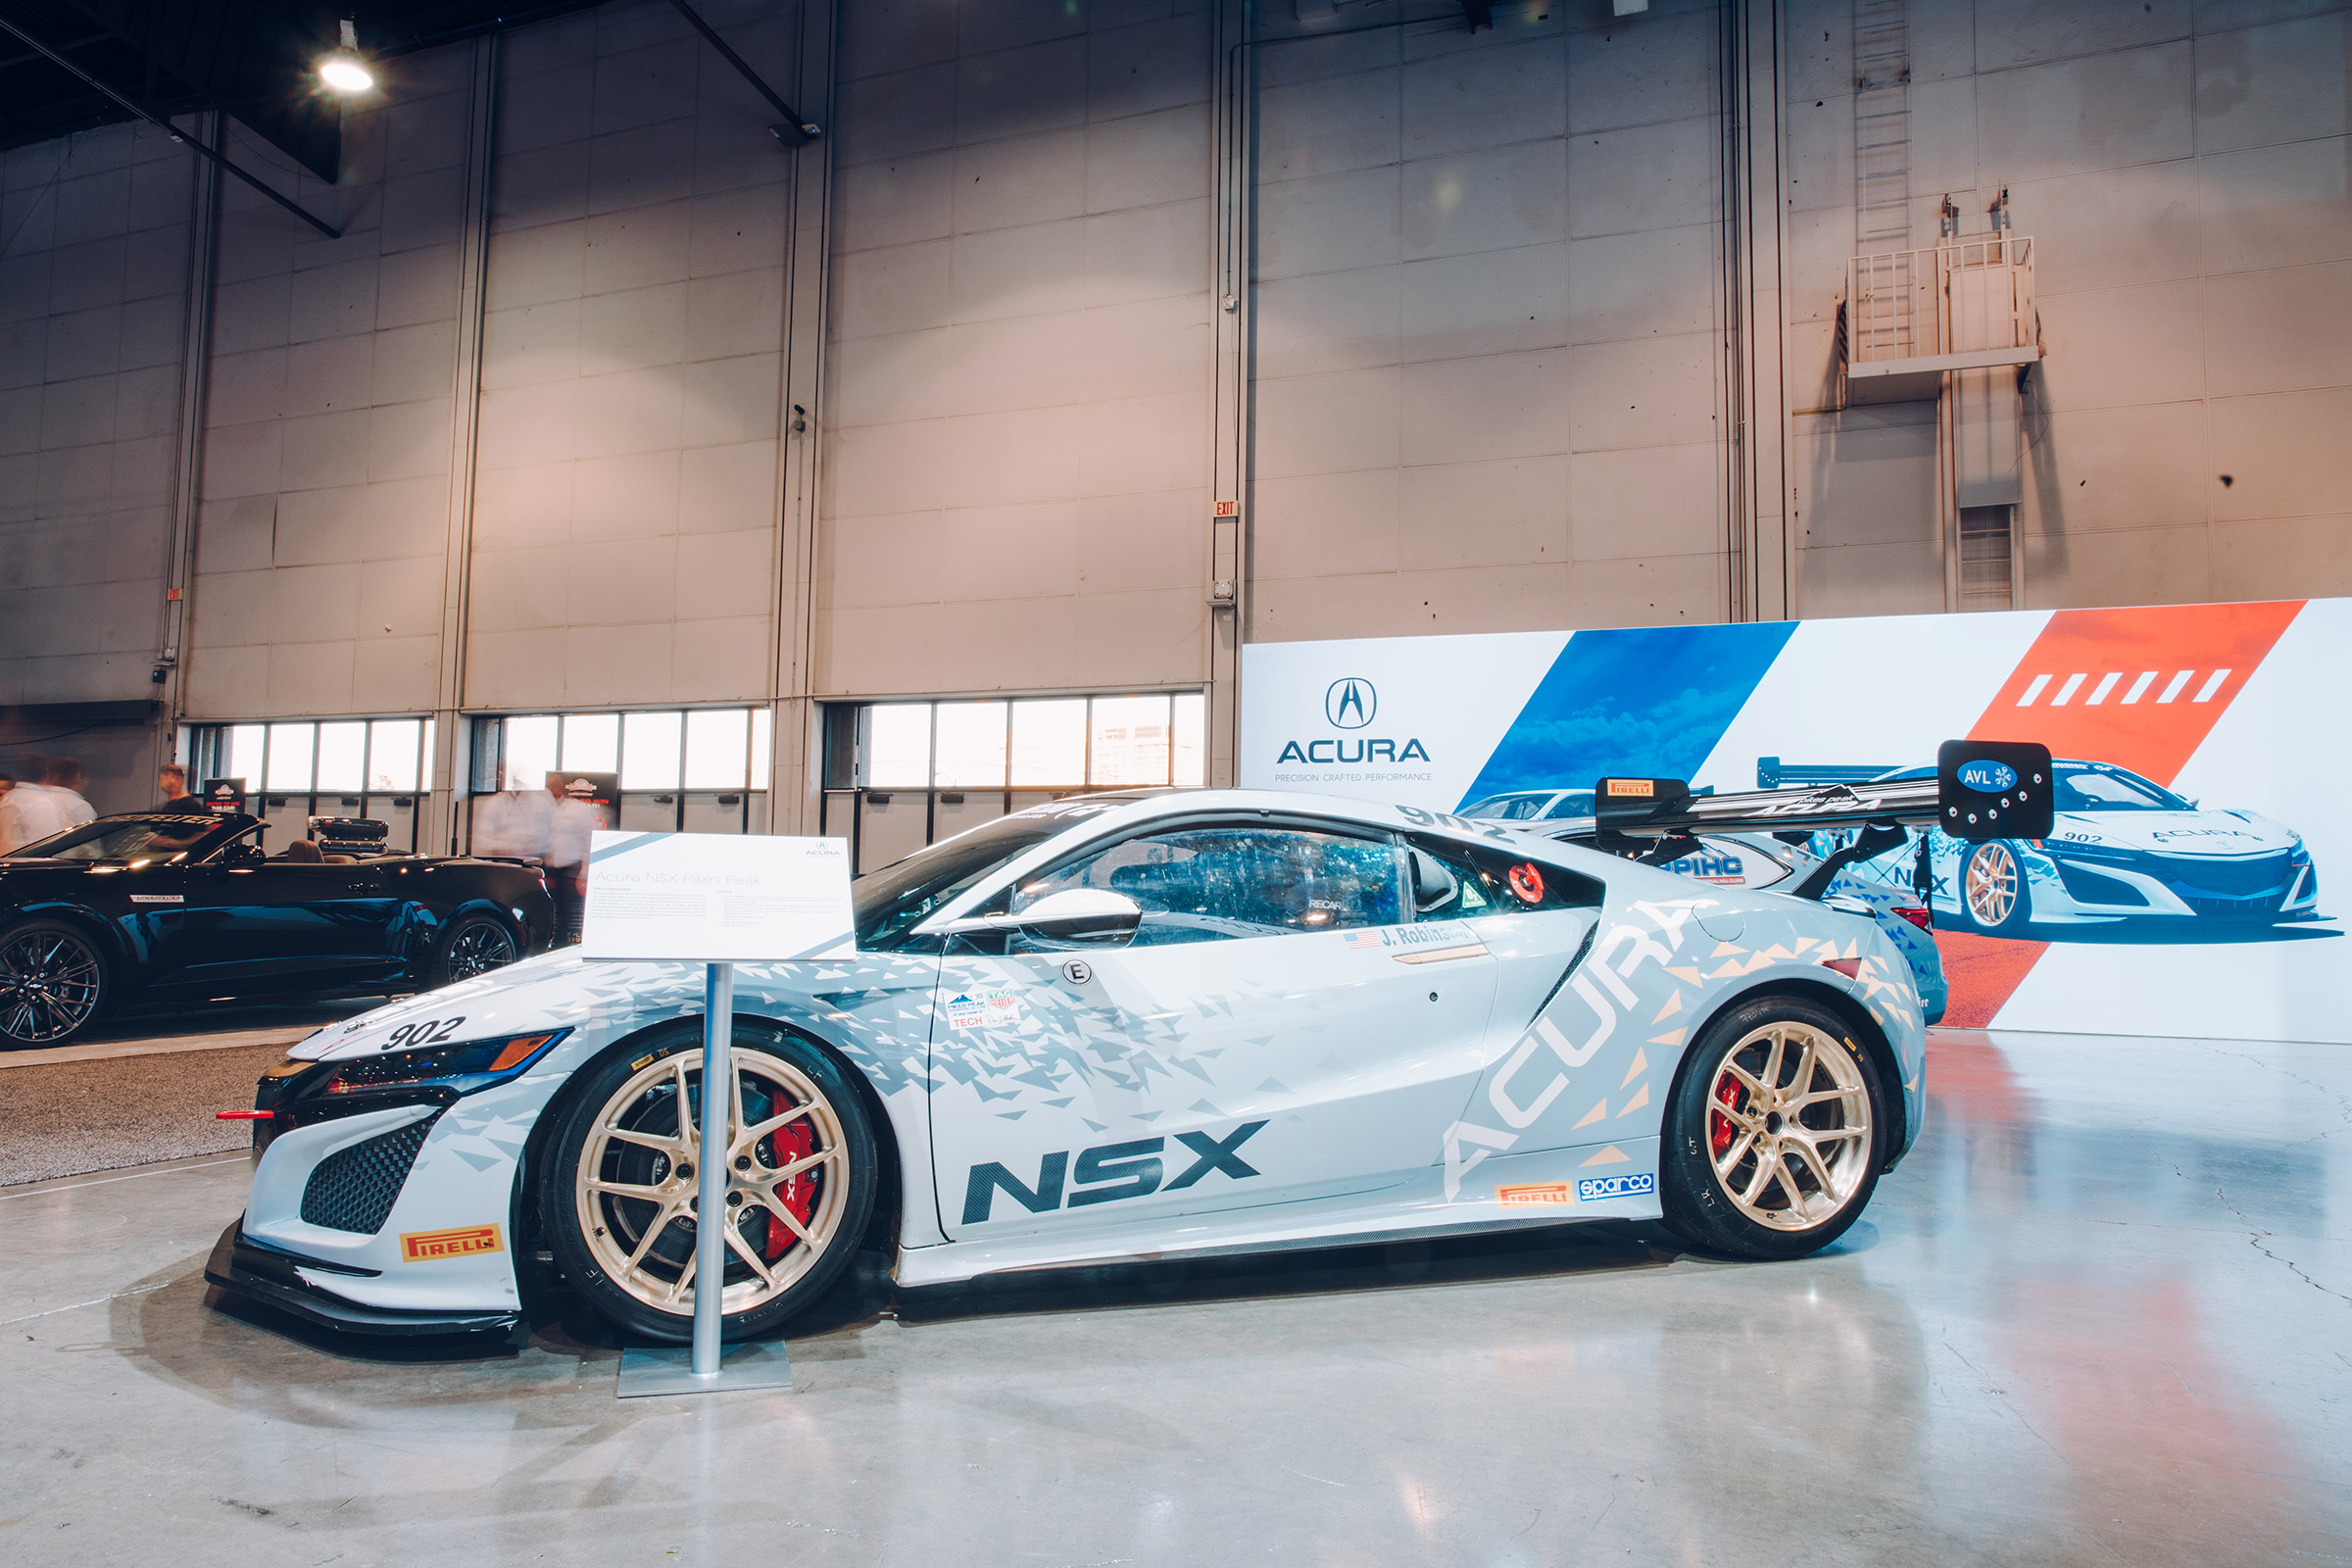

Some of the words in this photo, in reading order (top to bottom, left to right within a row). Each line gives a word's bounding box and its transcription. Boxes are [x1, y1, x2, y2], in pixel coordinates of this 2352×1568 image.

[1216, 501, 1234, 515] EXIT
[1276, 738, 1431, 763] ACURA
[1323, 773, 1361, 782] CRAFTED
[1365, 772, 1432, 782] PERFORMANCE
[1964, 769, 1990, 785] AVL
[1611, 783, 1649, 793] PIRELLI
[1741, 799, 1882, 817] ACURA
[1825, 794, 1855, 804] peak
[1396, 805, 1517, 845] 902
[2064, 832, 2102, 845] 902
[1657, 857, 1744, 876] PIHC
[595, 871, 641, 883] Acura
[646, 872, 678, 884] NSX
[683, 873, 721, 885] Pikes
[726, 874, 760, 886] Peak
[1894, 866, 1950, 896] NX
[1309, 899, 1342, 910] RECAR
[1381, 929, 1396, 947] J.
[1070, 963, 1085, 980] E
[954, 1016, 983, 1027] TECH
[380, 1016, 466, 1051] 902
[1445, 899, 1720, 1203] ACURA
[961, 1119, 1271, 1225] NSX
[1500, 1185, 1567, 1205] PIRELLI
[1580, 1174, 1653, 1200] sparco
[407, 1229, 495, 1257] PIRELLI
